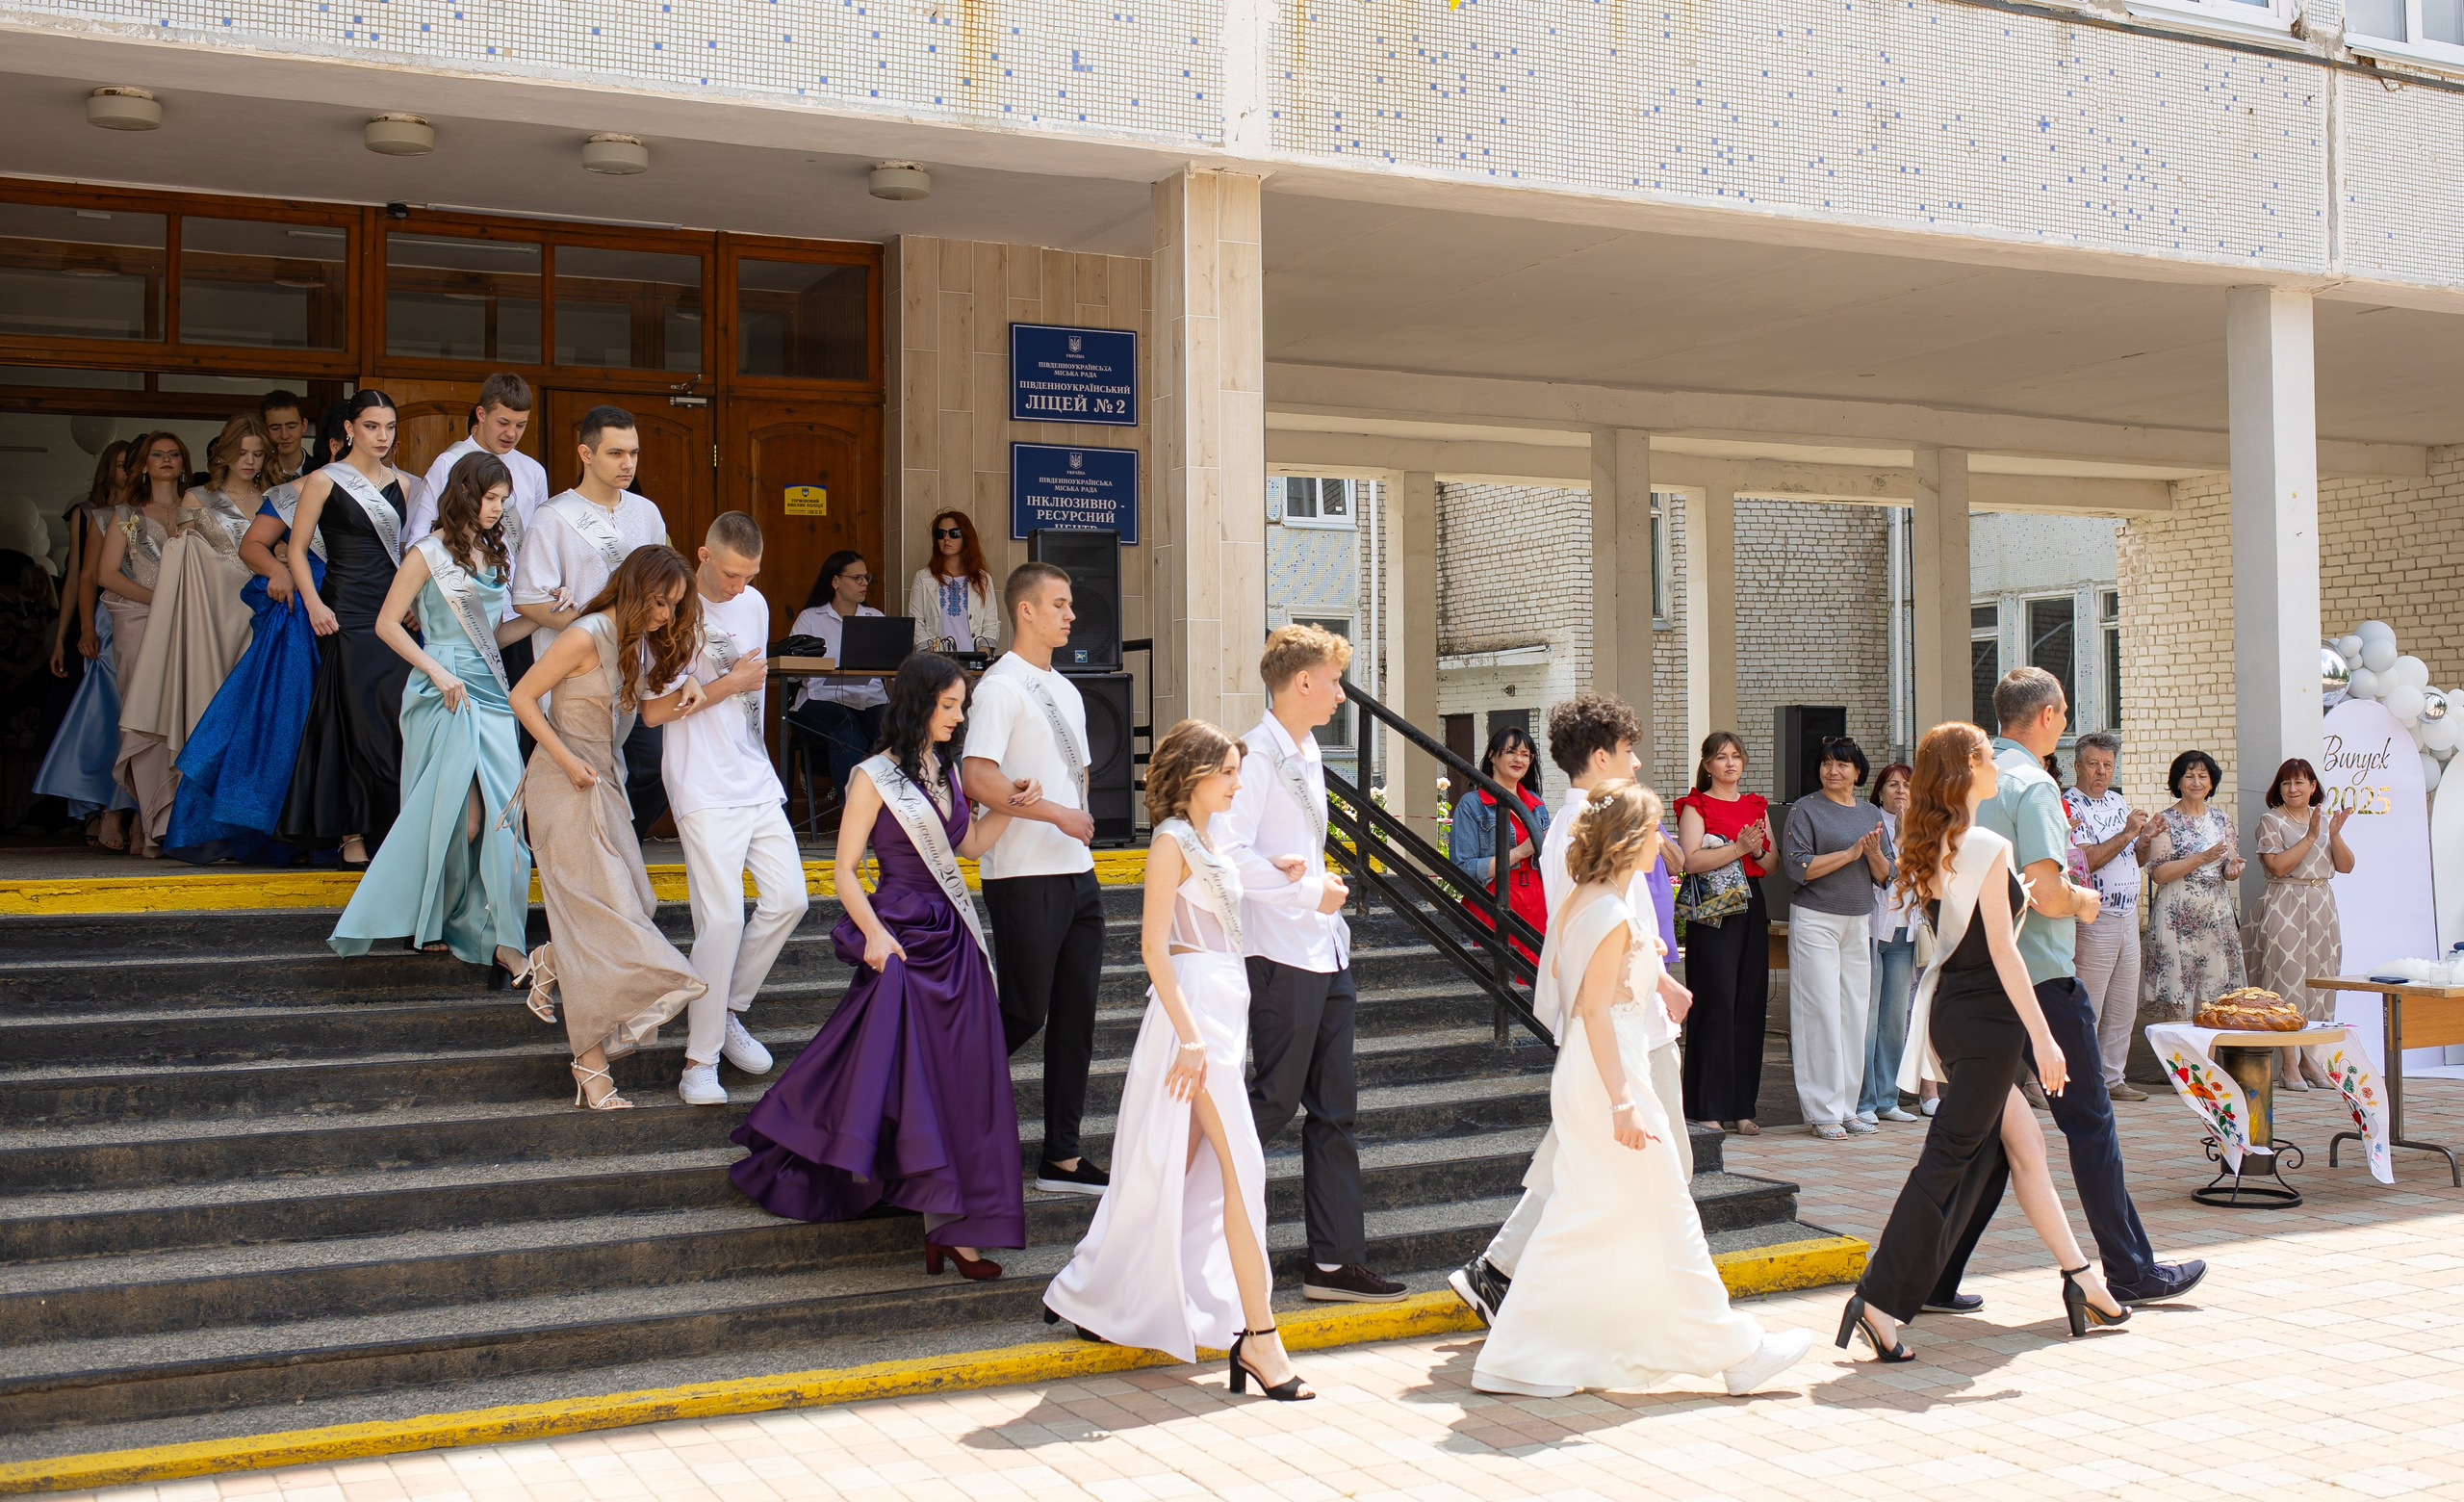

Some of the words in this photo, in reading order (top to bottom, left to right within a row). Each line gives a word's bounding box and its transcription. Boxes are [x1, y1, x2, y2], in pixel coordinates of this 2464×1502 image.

[1054, 369, 1080, 378] МІСЬКА
[1019, 379, 1131, 395] ПІВДЕННОУКРАЇНСЬКИЙ
[1025, 394, 1088, 413] ЛІЦЕЙ
[1039, 477, 1113, 487] ПІВДЕННОУКРАЇНСЬКА
[1054, 484, 1080, 493] МІСЬКА
[1026, 495, 1116, 510] ІНКЛЮЗИВНО
[1036, 508, 1116, 524] РЕСУРСНИЙ
[2323, 735, 2392, 786] Випуск
[2326, 786, 2392, 816] 2025
[937, 864, 970, 913] 2025
